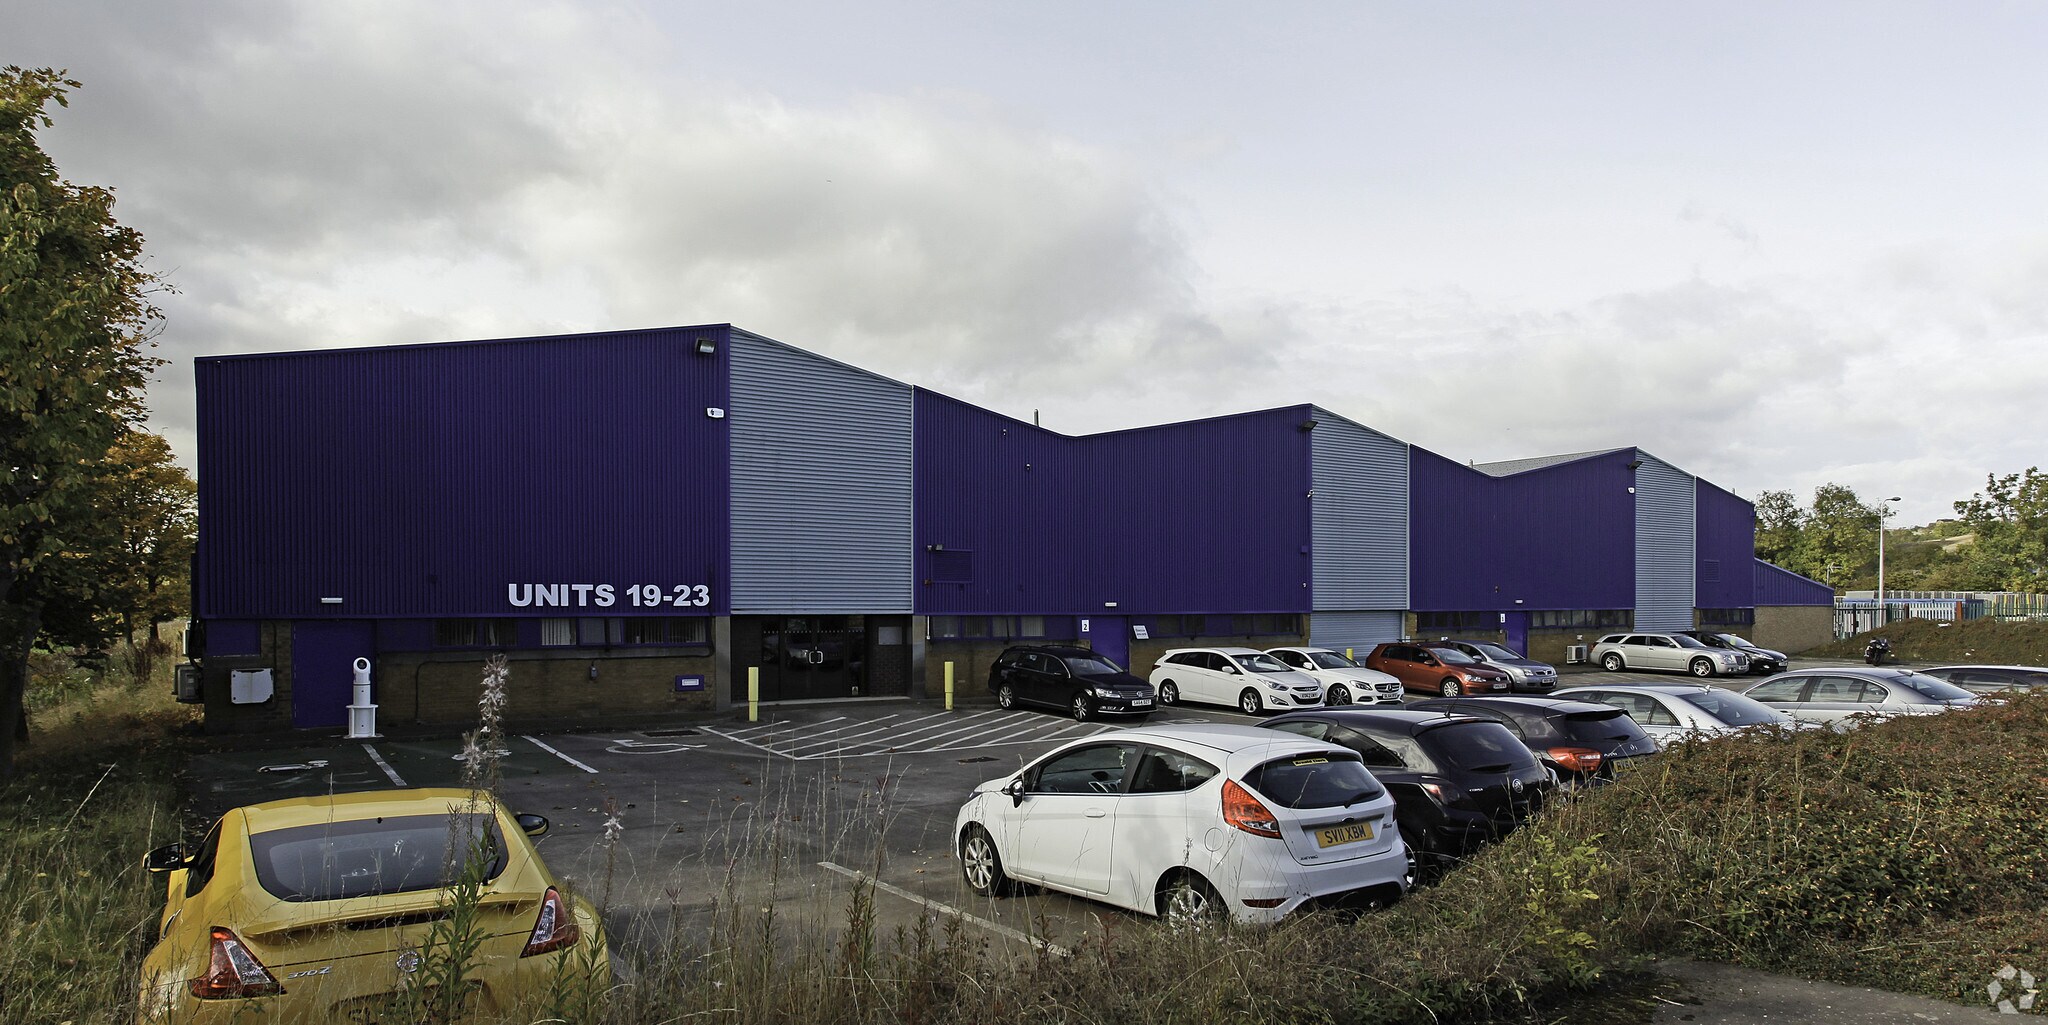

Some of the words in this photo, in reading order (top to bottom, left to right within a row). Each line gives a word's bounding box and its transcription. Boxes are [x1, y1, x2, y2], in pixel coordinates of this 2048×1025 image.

[508, 584, 616, 607] UNITS
[626, 584, 710, 607] 19-23
[1083, 623, 1089, 631] 2
[1324, 829, 1345, 844] SV11
[1346, 825, 1366, 840] XBM
